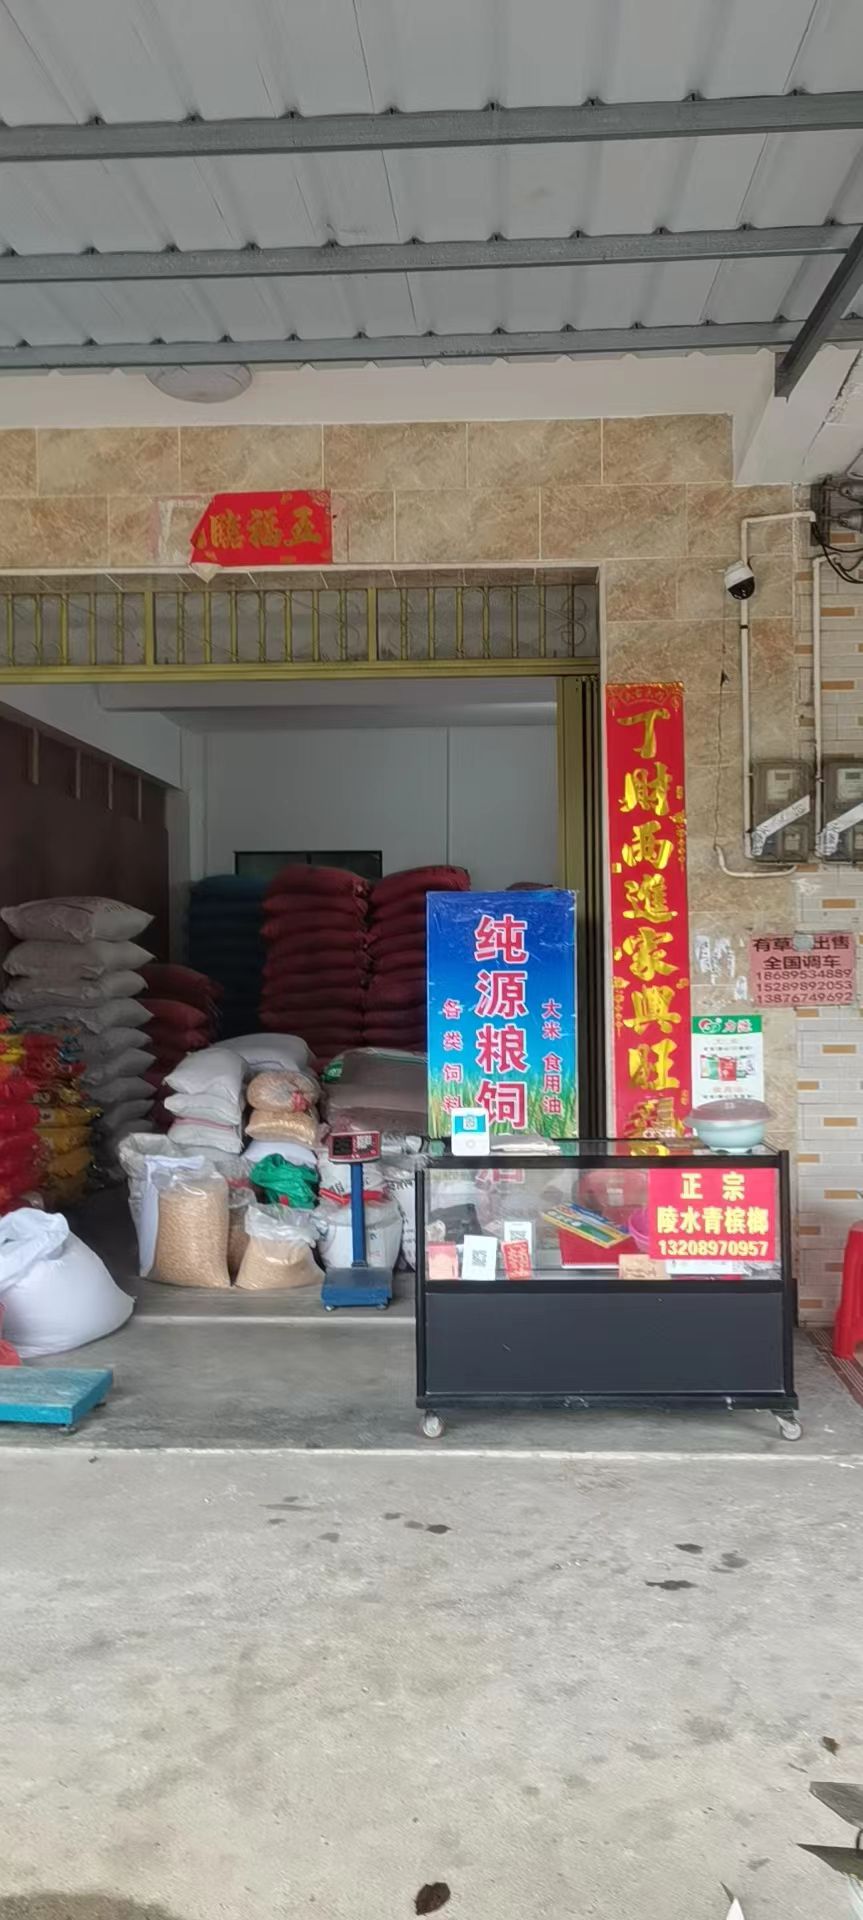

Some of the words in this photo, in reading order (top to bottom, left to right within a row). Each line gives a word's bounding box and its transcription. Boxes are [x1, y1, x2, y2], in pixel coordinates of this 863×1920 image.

[753, 936, 850, 952] 有草出售
[763, 955, 841, 970] 全国调车
[756, 969, 852, 981] 18689534889
[756, 981, 853, 992] 15289892053
[757, 992, 853, 1003] 13876749692
[657, 1205, 769, 1235] 陵水青槟榔
[658, 1240, 769, 1257] 13208970957
